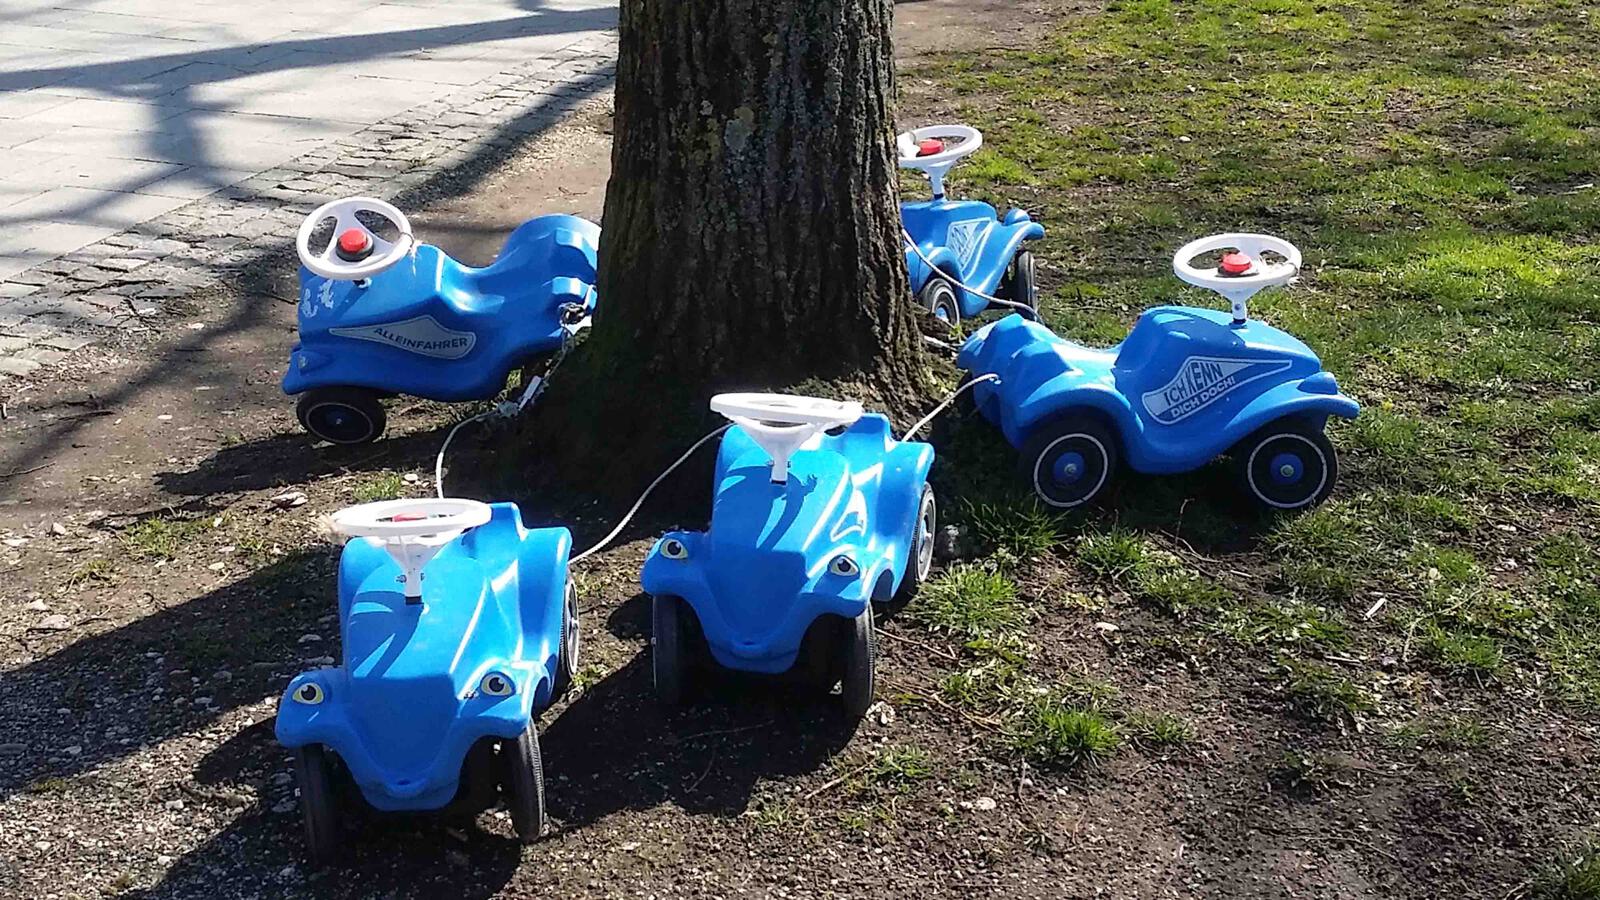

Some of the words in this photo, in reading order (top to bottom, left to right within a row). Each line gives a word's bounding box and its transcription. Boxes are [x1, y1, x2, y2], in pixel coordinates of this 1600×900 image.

[374, 327, 468, 351] ALLEINFAHRER
[1164, 377, 1188, 406] ICH
[1185, 362, 1224, 395] KENN
[1170, 397, 1200, 418] DICH
[1200, 376, 1236, 402] DOCH!
